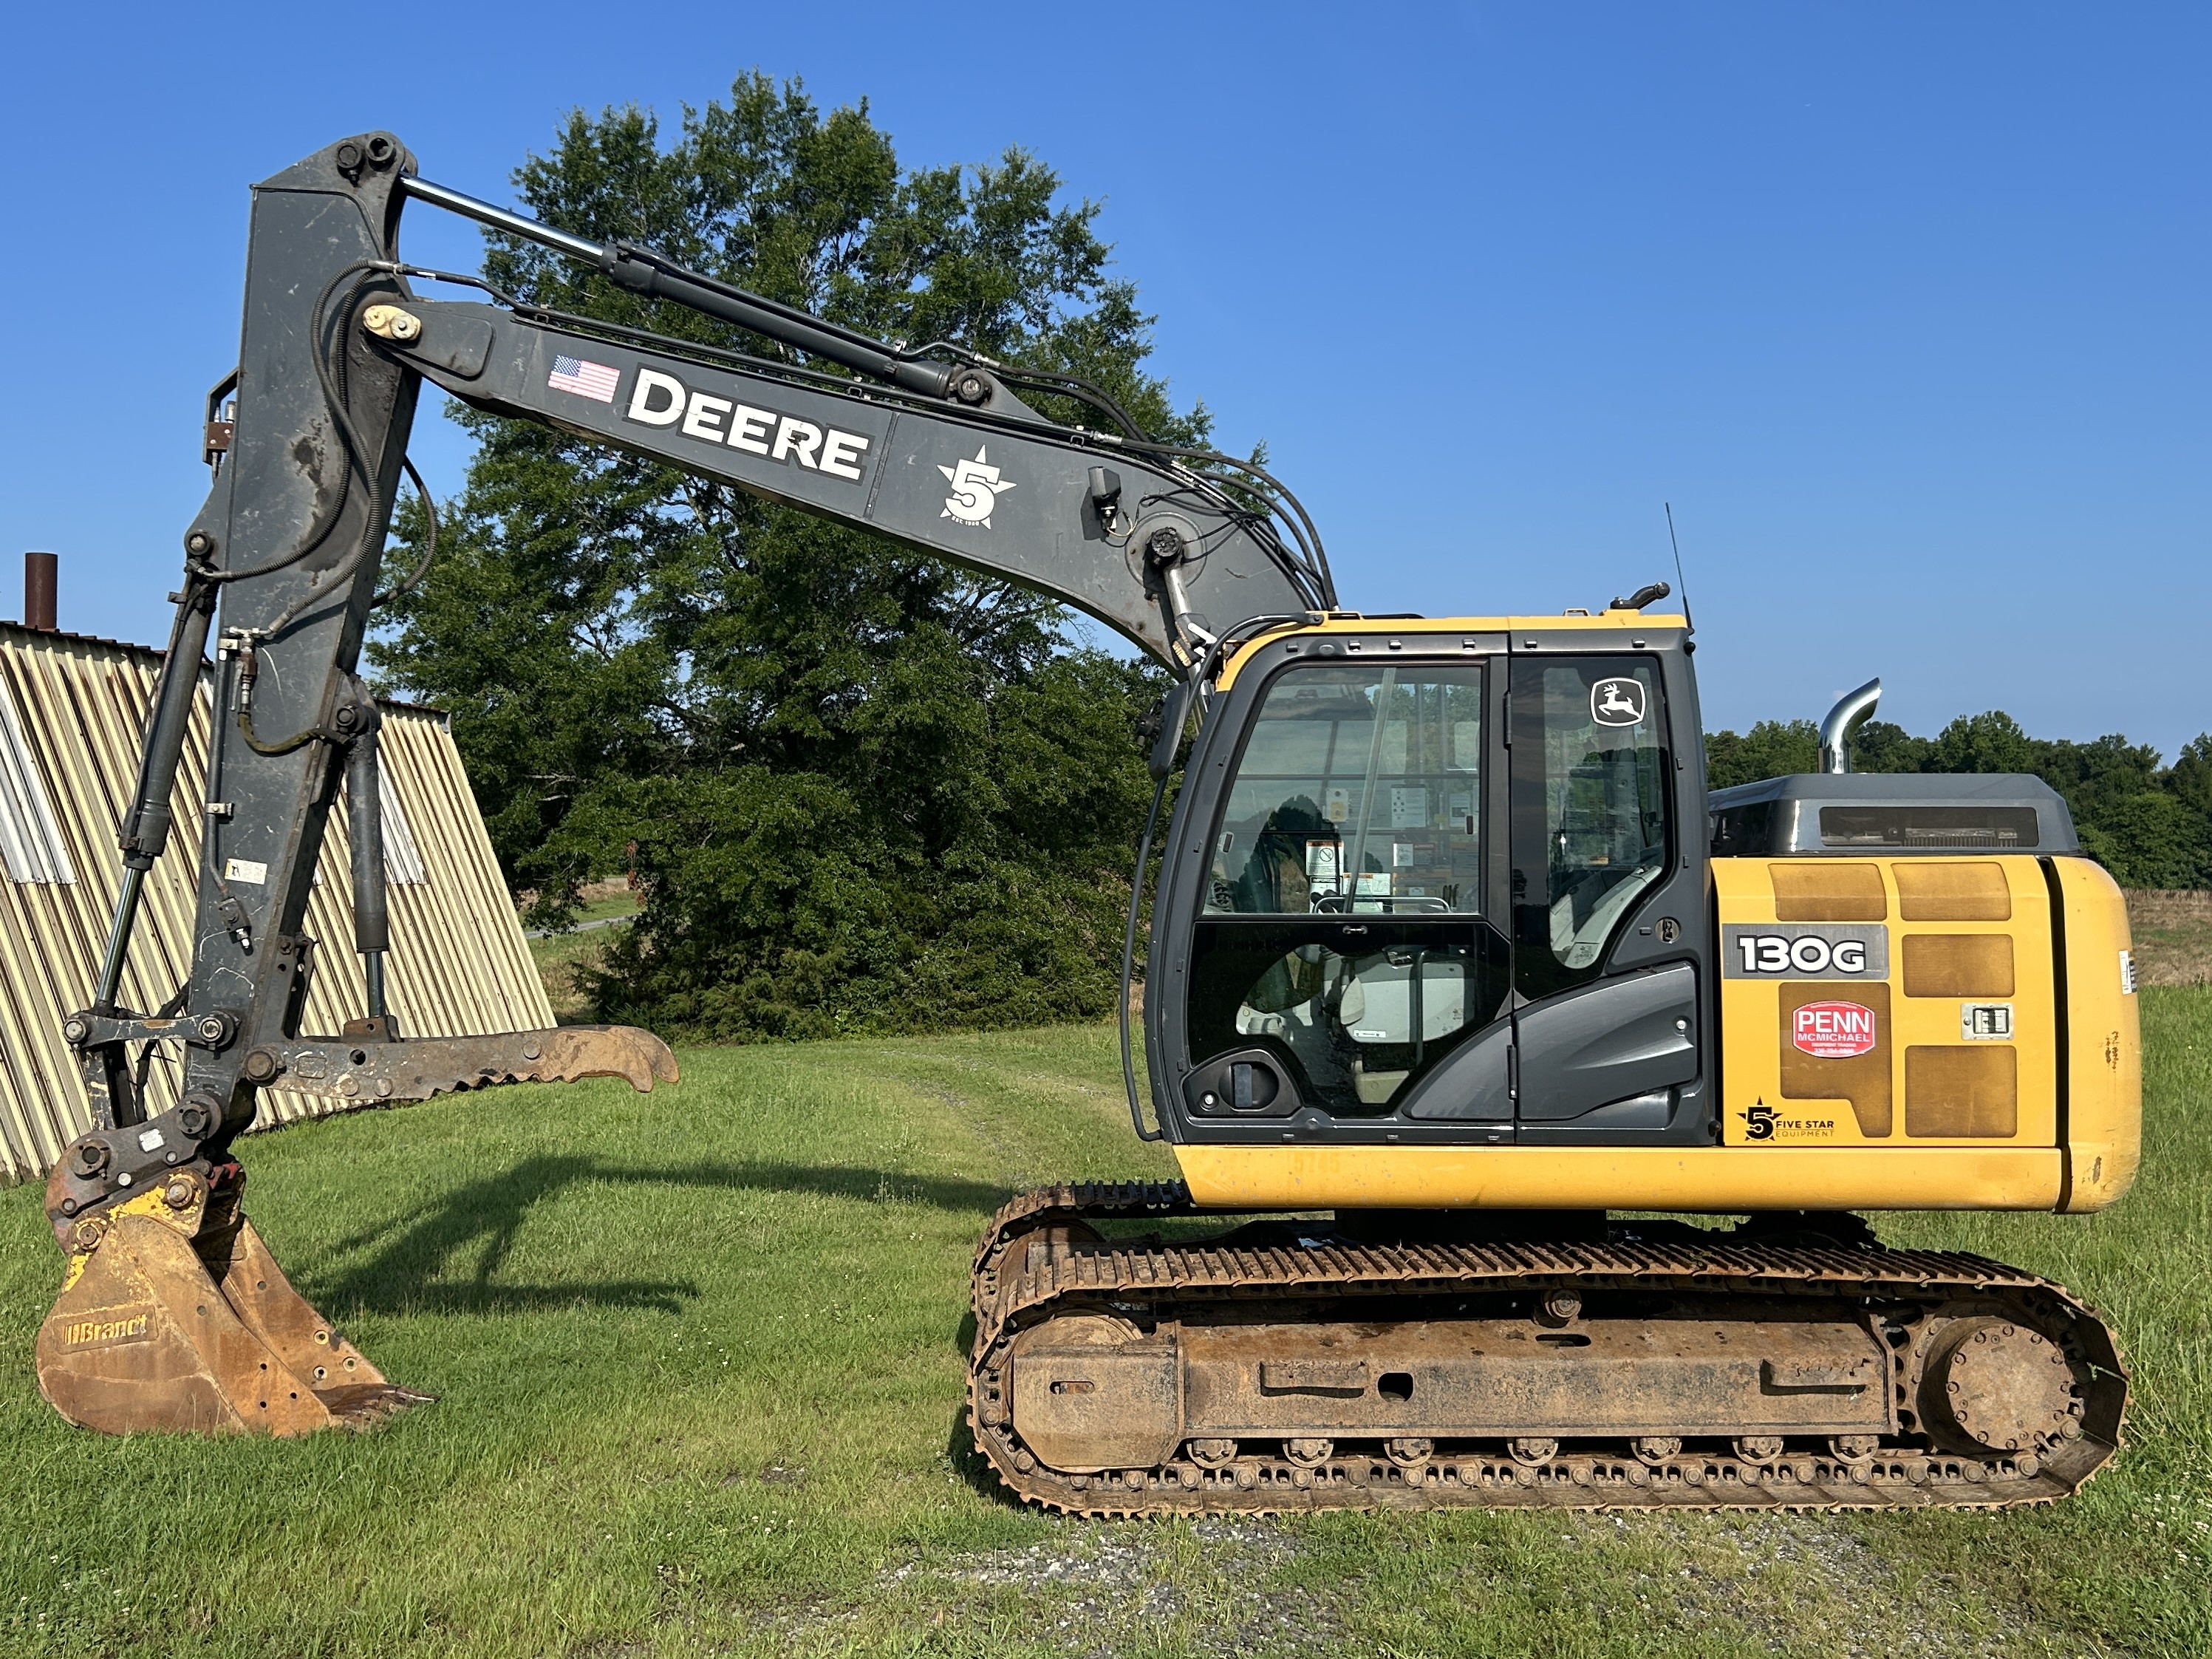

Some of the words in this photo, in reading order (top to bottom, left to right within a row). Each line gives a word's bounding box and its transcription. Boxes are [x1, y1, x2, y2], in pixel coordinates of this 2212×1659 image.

[628, 368, 869, 480] DEERE
[946, 458, 1000, 521] 5
[1738, 936, 1865, 973] 130G
[1798, 1011, 1869, 1033] PENN
[1798, 1033, 1870, 1042] MCMICHAEL
[1746, 1106, 1773, 1139] 5
[1775, 1120, 1801, 1128] FIVE
[1806, 1120, 1834, 1128] STAR
